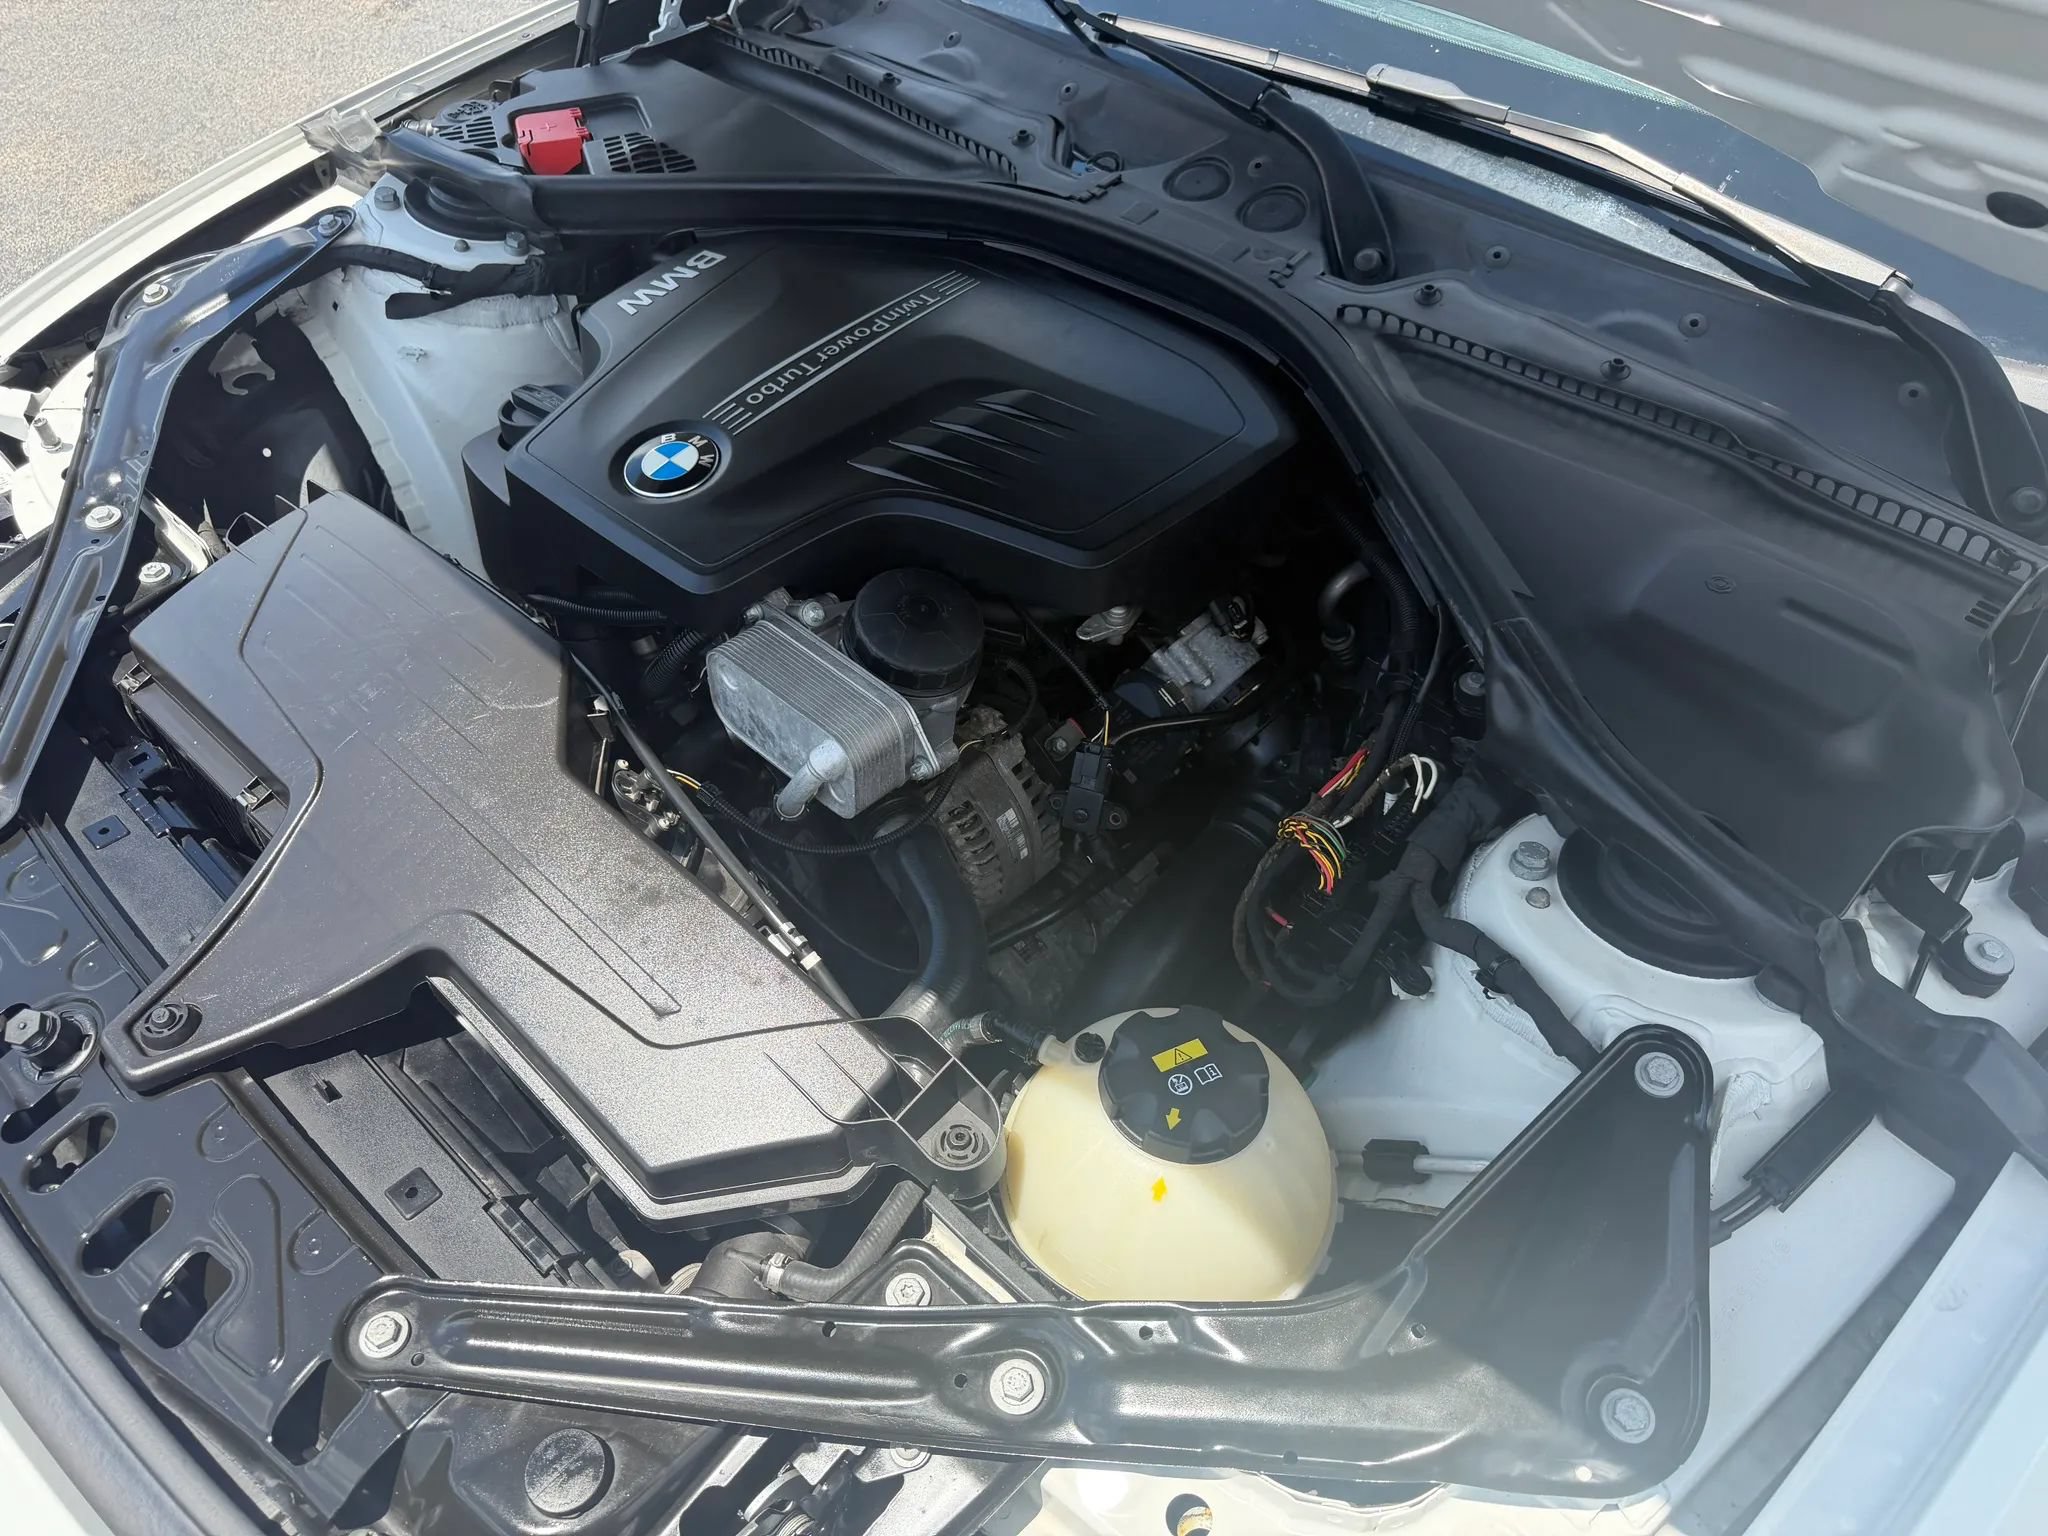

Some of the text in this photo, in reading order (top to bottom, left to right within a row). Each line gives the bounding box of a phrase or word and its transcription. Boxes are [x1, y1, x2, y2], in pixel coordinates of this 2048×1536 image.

[617, 250, 727, 316] BMW
[746, 294, 941, 405] TwinPower Turbo
[661, 433, 715, 468] BMW
